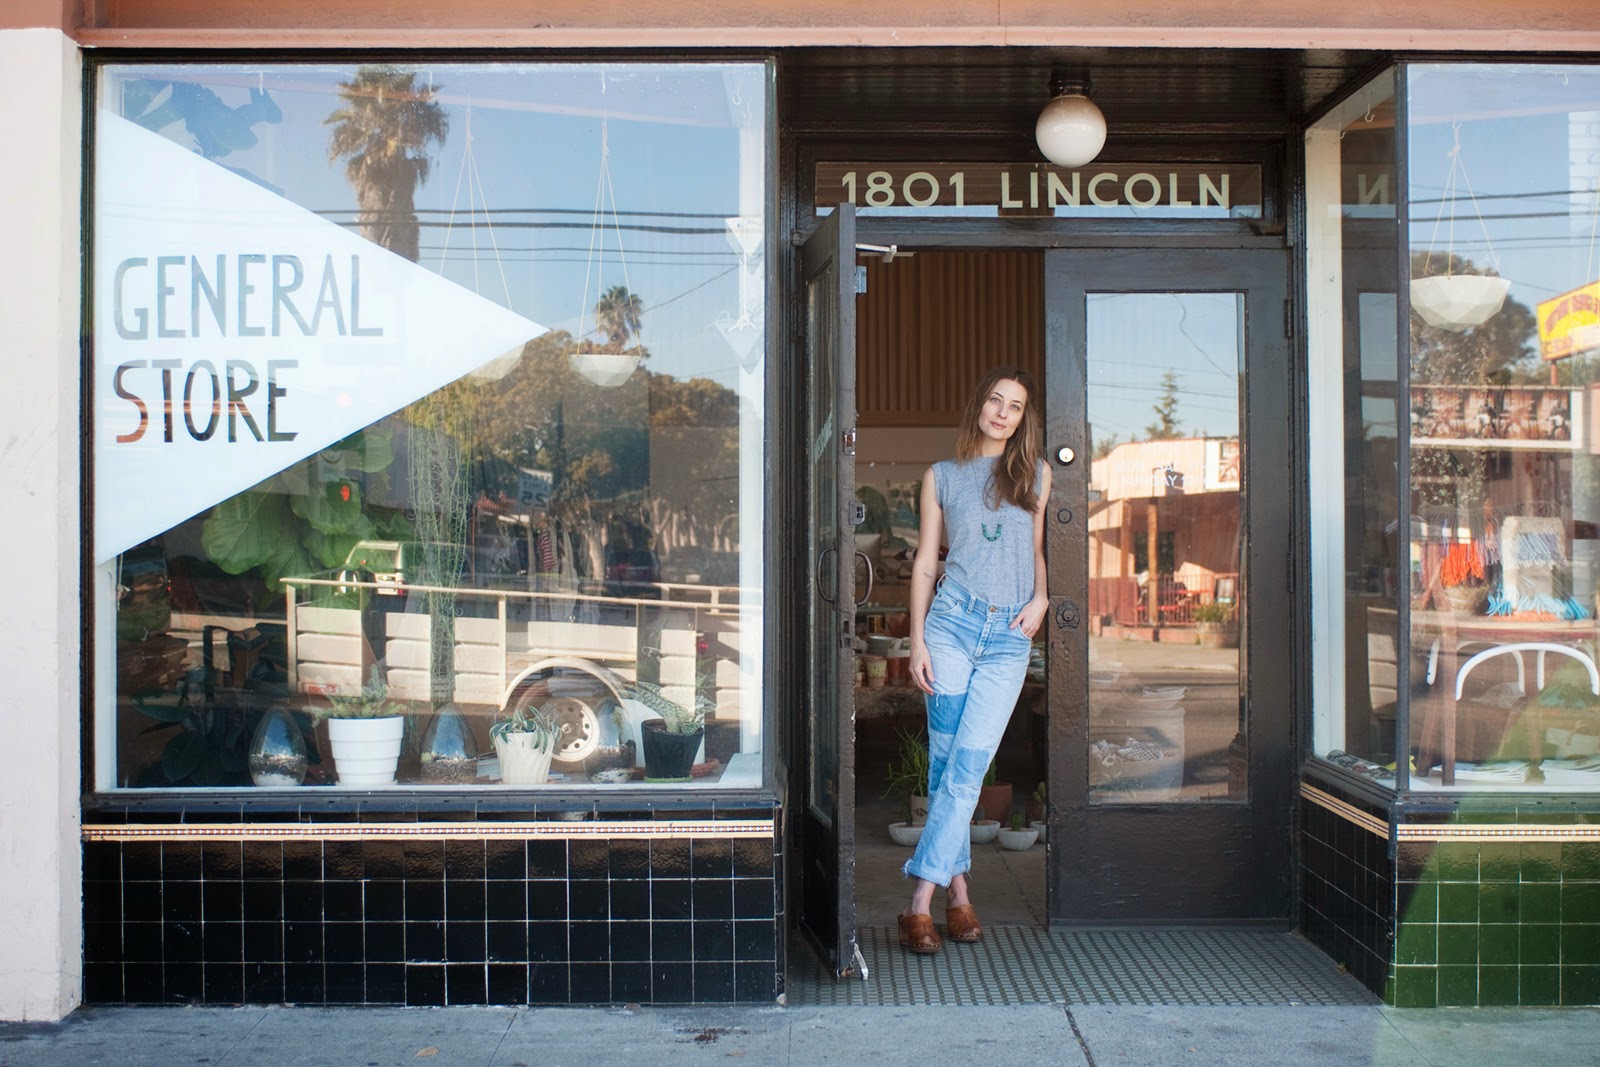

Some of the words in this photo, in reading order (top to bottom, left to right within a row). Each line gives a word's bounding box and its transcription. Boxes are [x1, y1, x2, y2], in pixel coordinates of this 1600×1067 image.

[842, 171, 964, 207] 1801
[1001, 172, 1230, 209] LINCOLN
[113, 254, 384, 340] GENERAL
[113, 359, 299, 443] STORE
